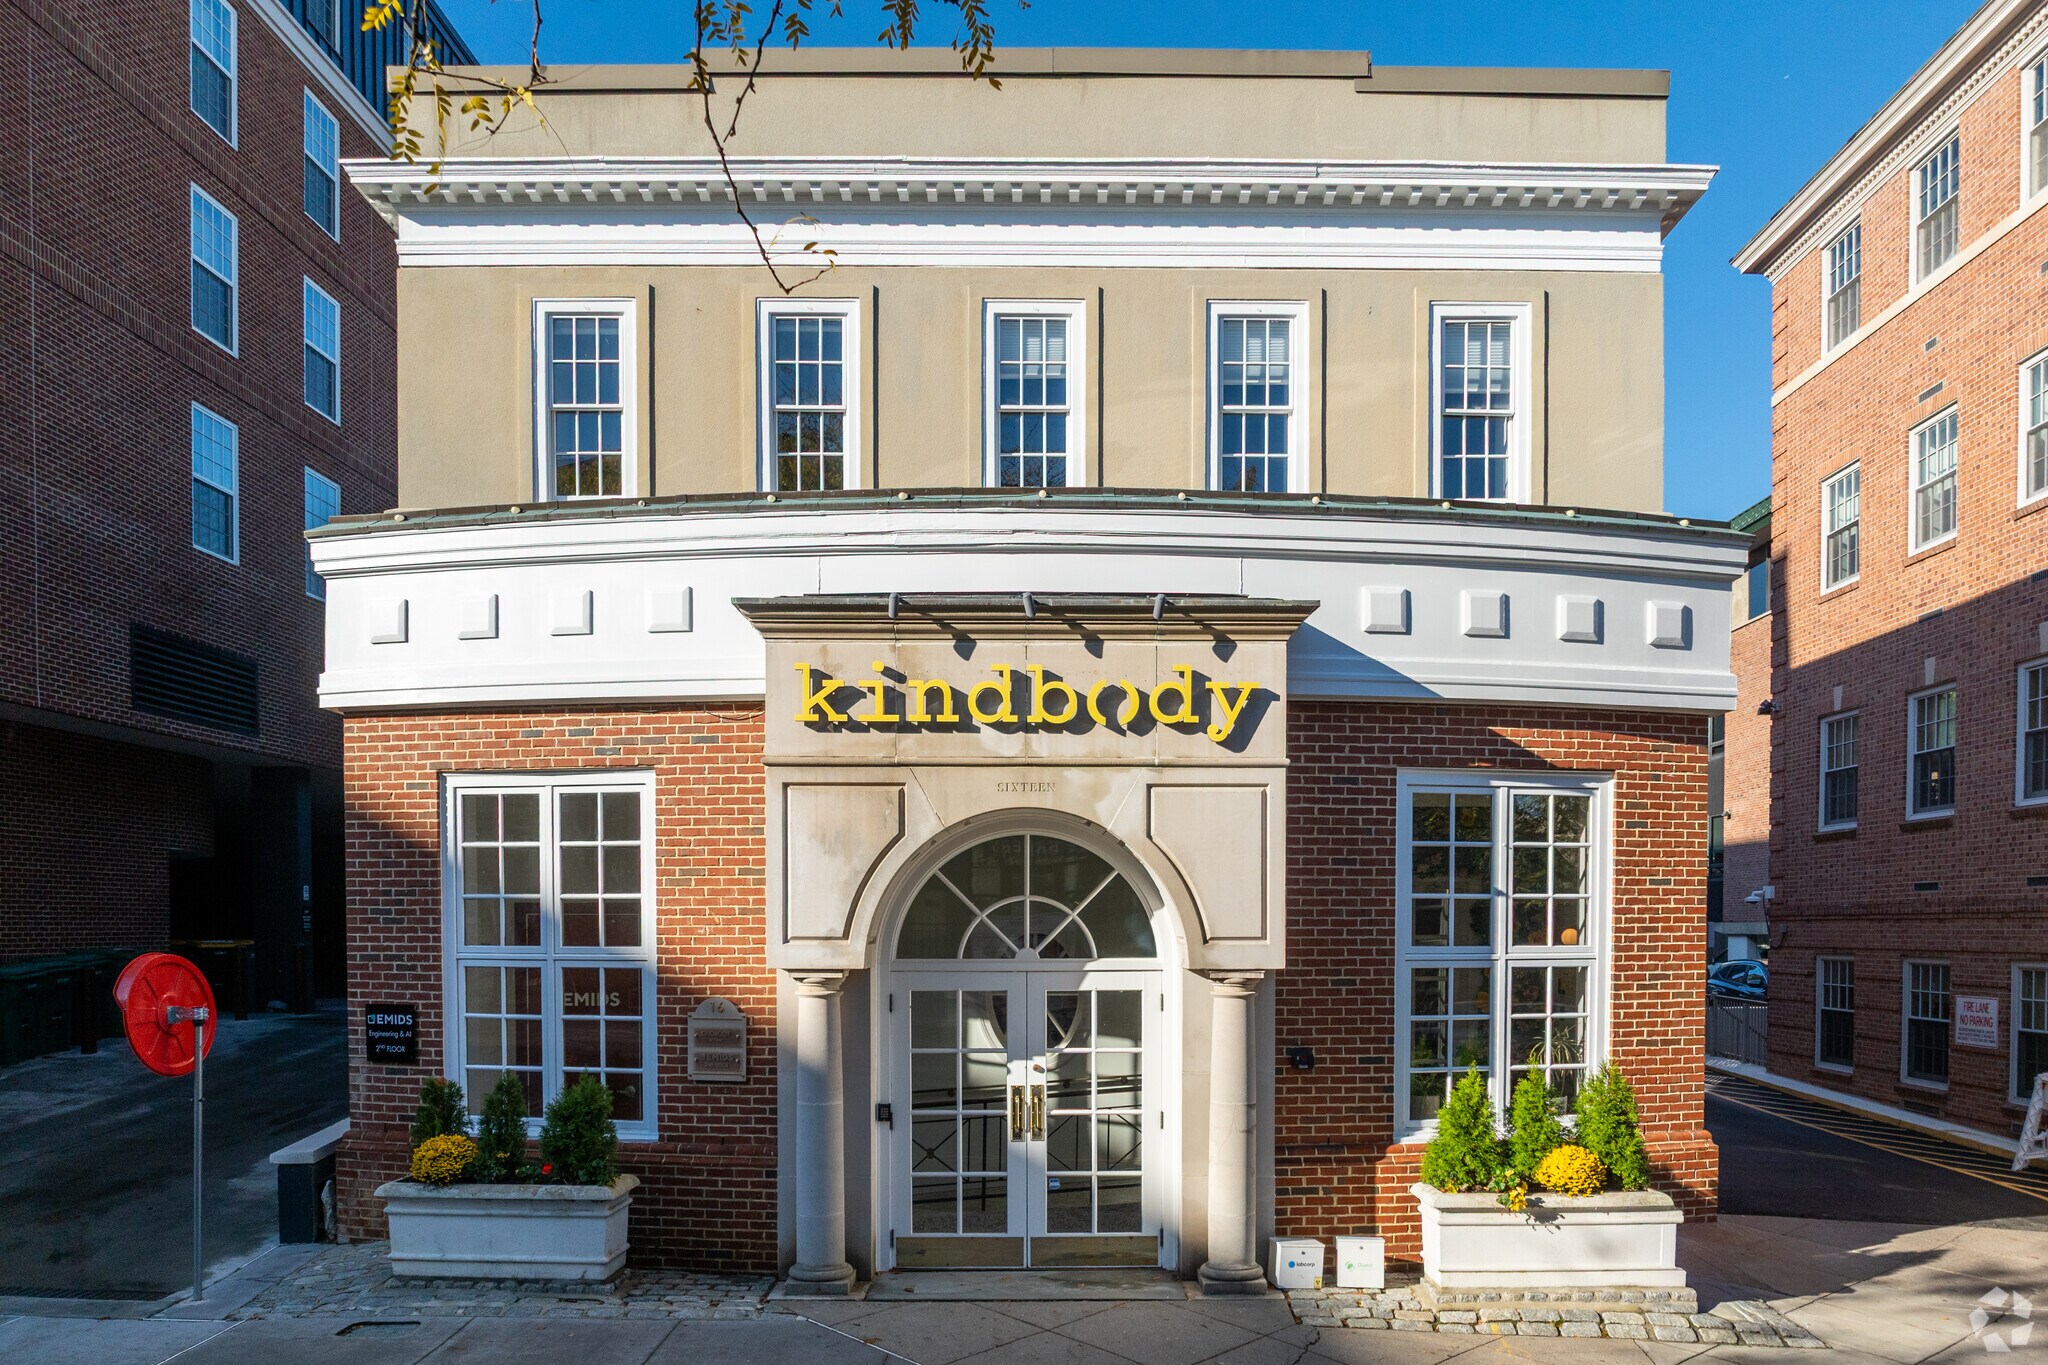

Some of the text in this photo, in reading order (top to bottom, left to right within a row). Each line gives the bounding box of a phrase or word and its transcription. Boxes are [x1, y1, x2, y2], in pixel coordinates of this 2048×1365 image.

[794, 661, 1259, 742] kindbody
[997, 782, 1056, 792] SIXTEEN
[710, 1002, 725, 1014] 16
[1963, 1001, 1990, 1014] FIRE LANE
[377, 1014, 413, 1025] EMIDS
[1960, 1014, 1993, 1028] NO PARKING
[368, 1030, 399, 1039] Engineering
